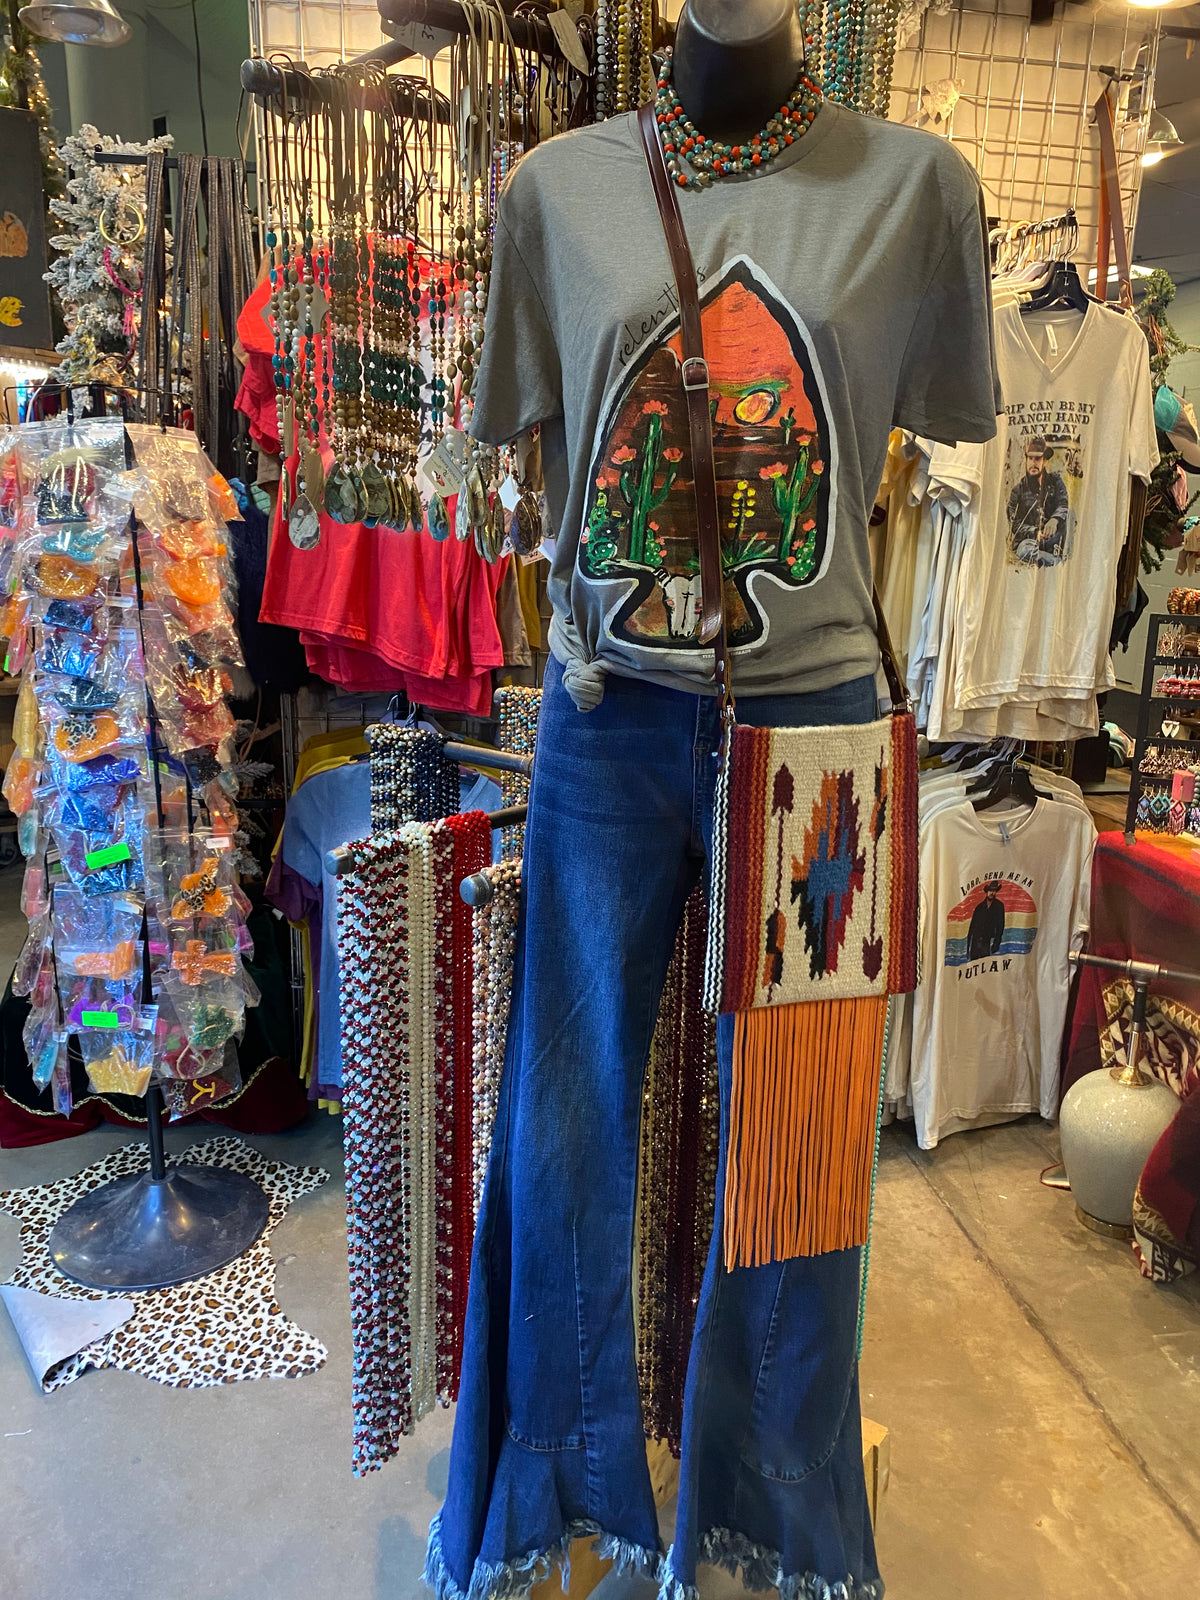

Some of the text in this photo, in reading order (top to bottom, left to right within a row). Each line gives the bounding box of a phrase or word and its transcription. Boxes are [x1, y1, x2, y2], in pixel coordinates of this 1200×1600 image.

[1030, 401, 1054, 411] CAN
[1059, 401, 1075, 411] BE
[1078, 403, 1095, 414] MY
[1008, 412, 1090, 426] RANCH HAND
[1020, 423, 1078, 435] ANY DAY
[984, 871, 1004, 881] SEND
[1007, 871, 1020, 881] ME
[1021, 876, 1034, 888] AN
